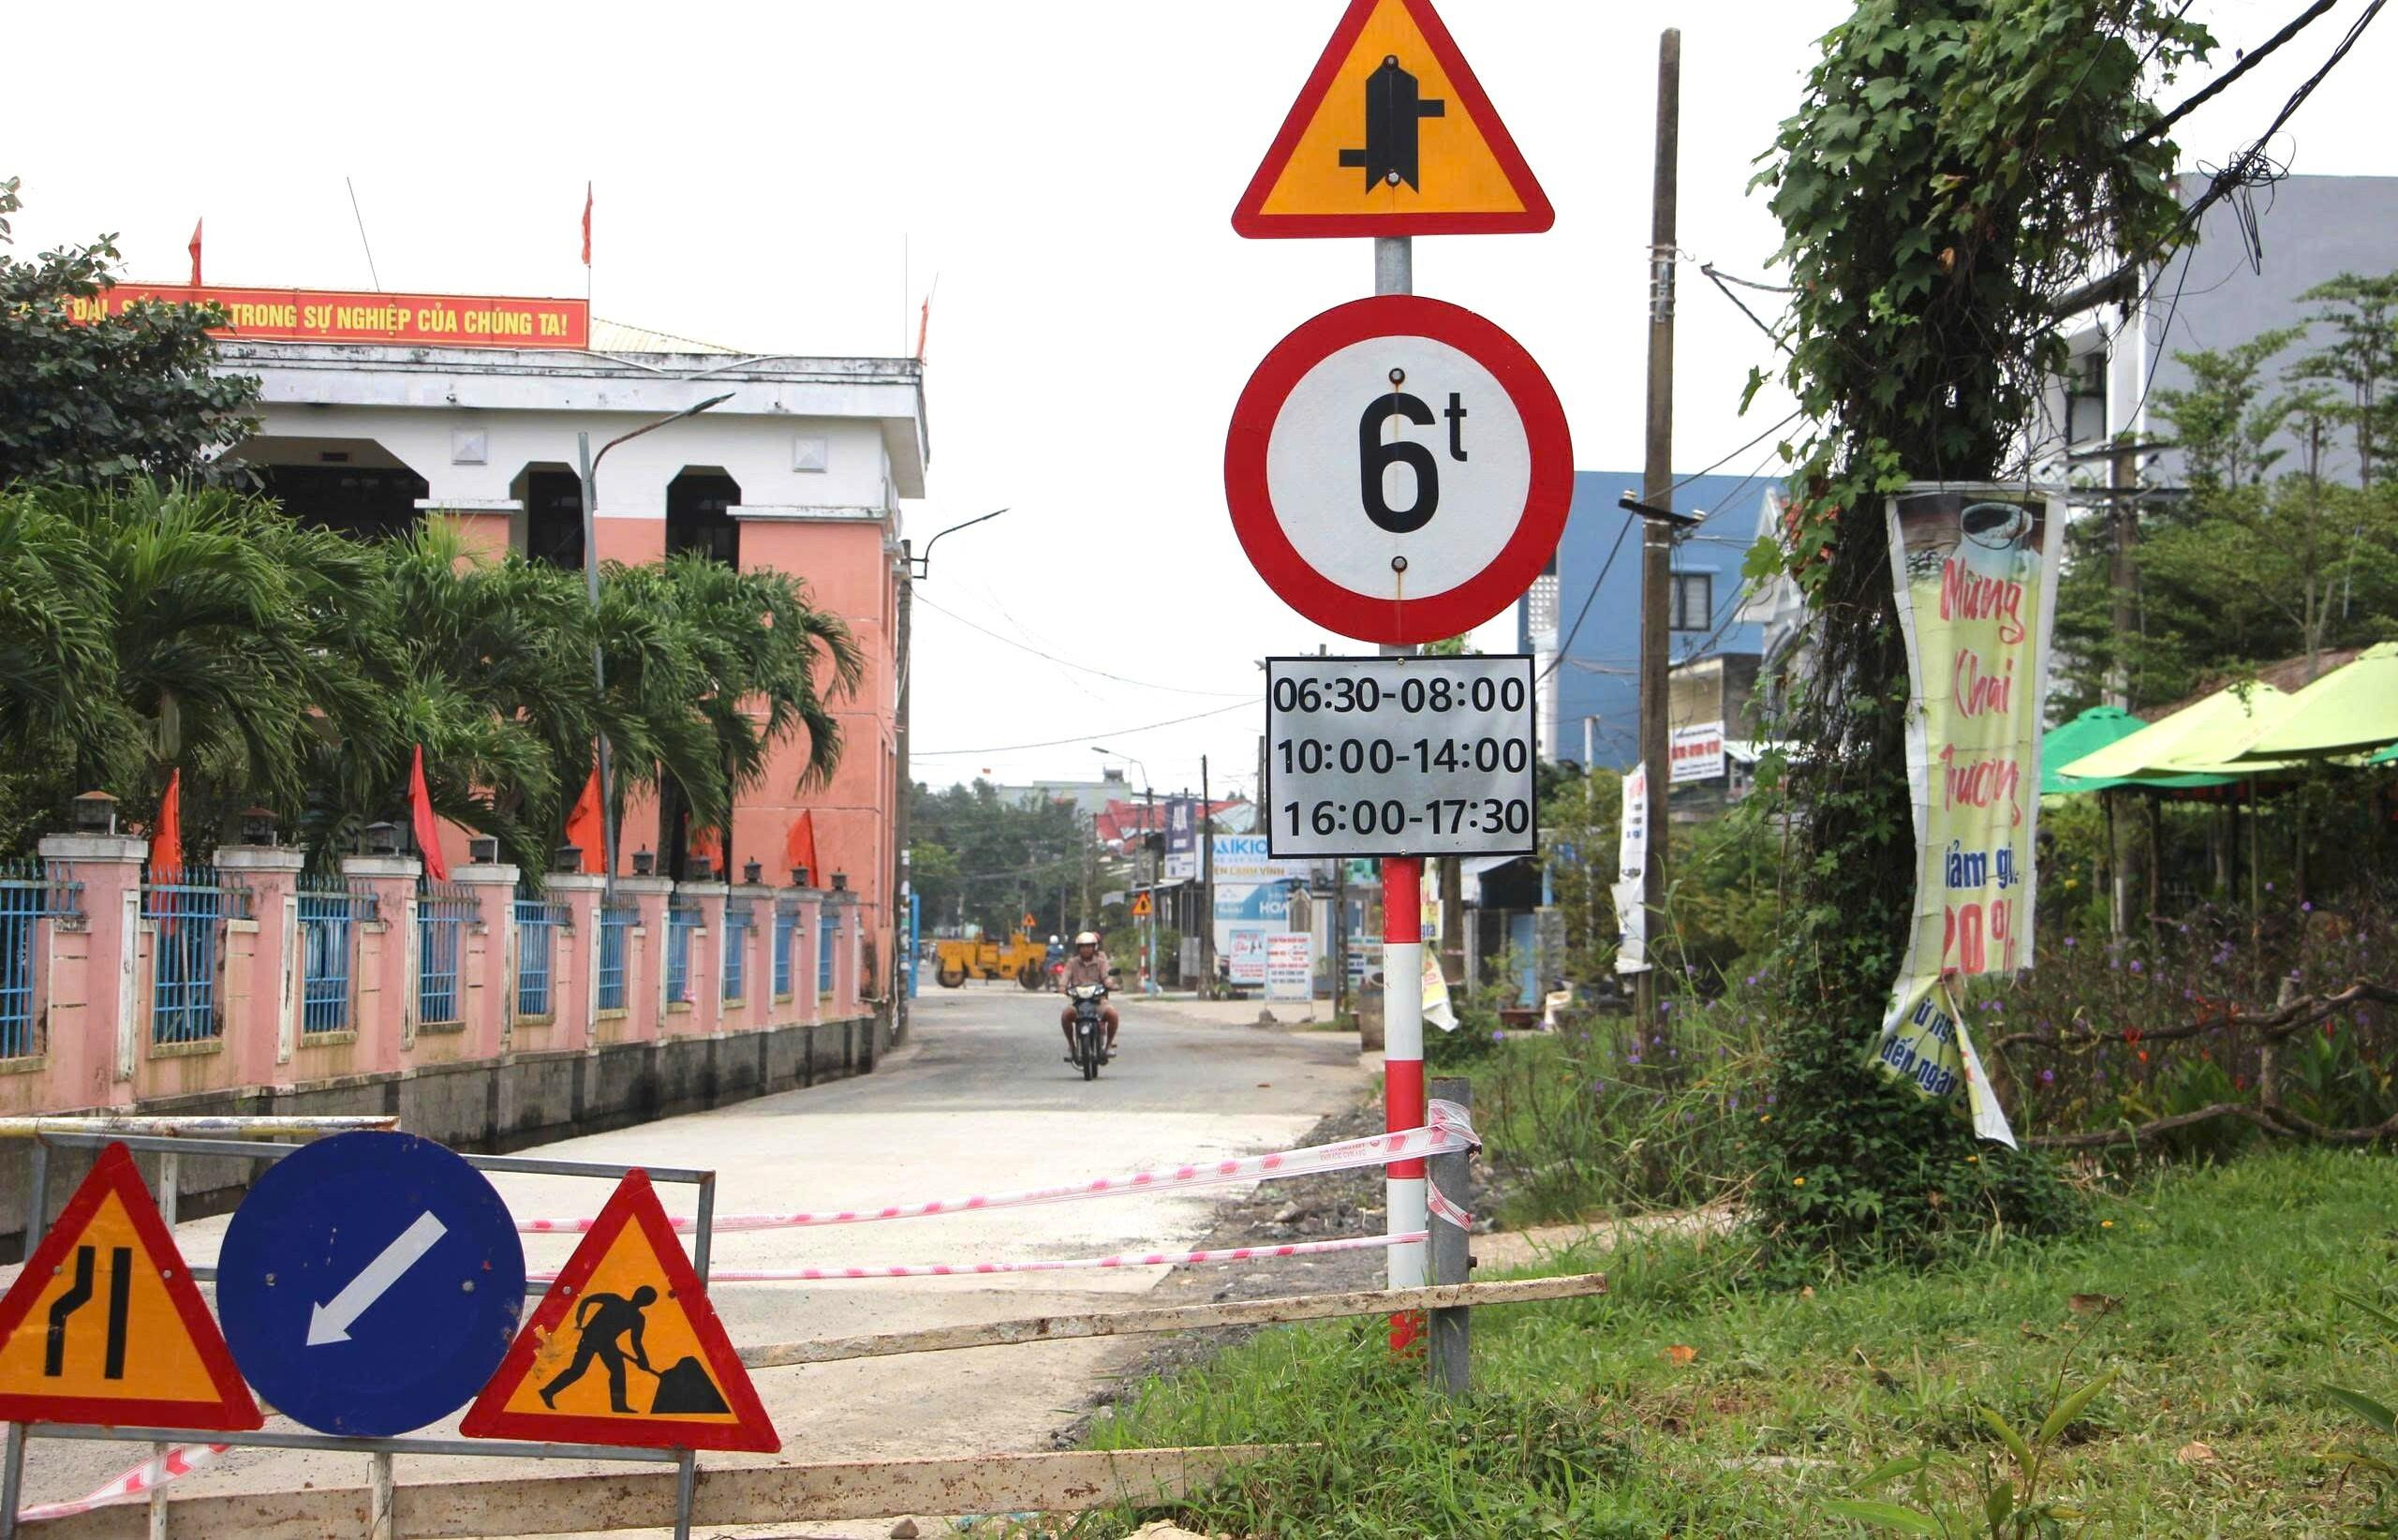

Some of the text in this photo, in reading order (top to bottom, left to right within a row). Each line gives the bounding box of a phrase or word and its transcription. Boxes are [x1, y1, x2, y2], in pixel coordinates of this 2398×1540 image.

[230, 304, 297, 327] TRONG
[303, 304, 333, 333] SỰ
[336, 304, 411, 335] NGHIỆP
[418, 302, 458, 333] CỦA
[464, 307, 532, 334] CHÚNG
[539, 313, 568, 336] TA!
[1273, 677, 1525, 713] 06:30-08:00
[1278, 737, 1527, 774] 10:00-14:00
[1284, 798, 1529, 837] 16:00-17:30
[1212, 838, 1268, 854] AIKIO
